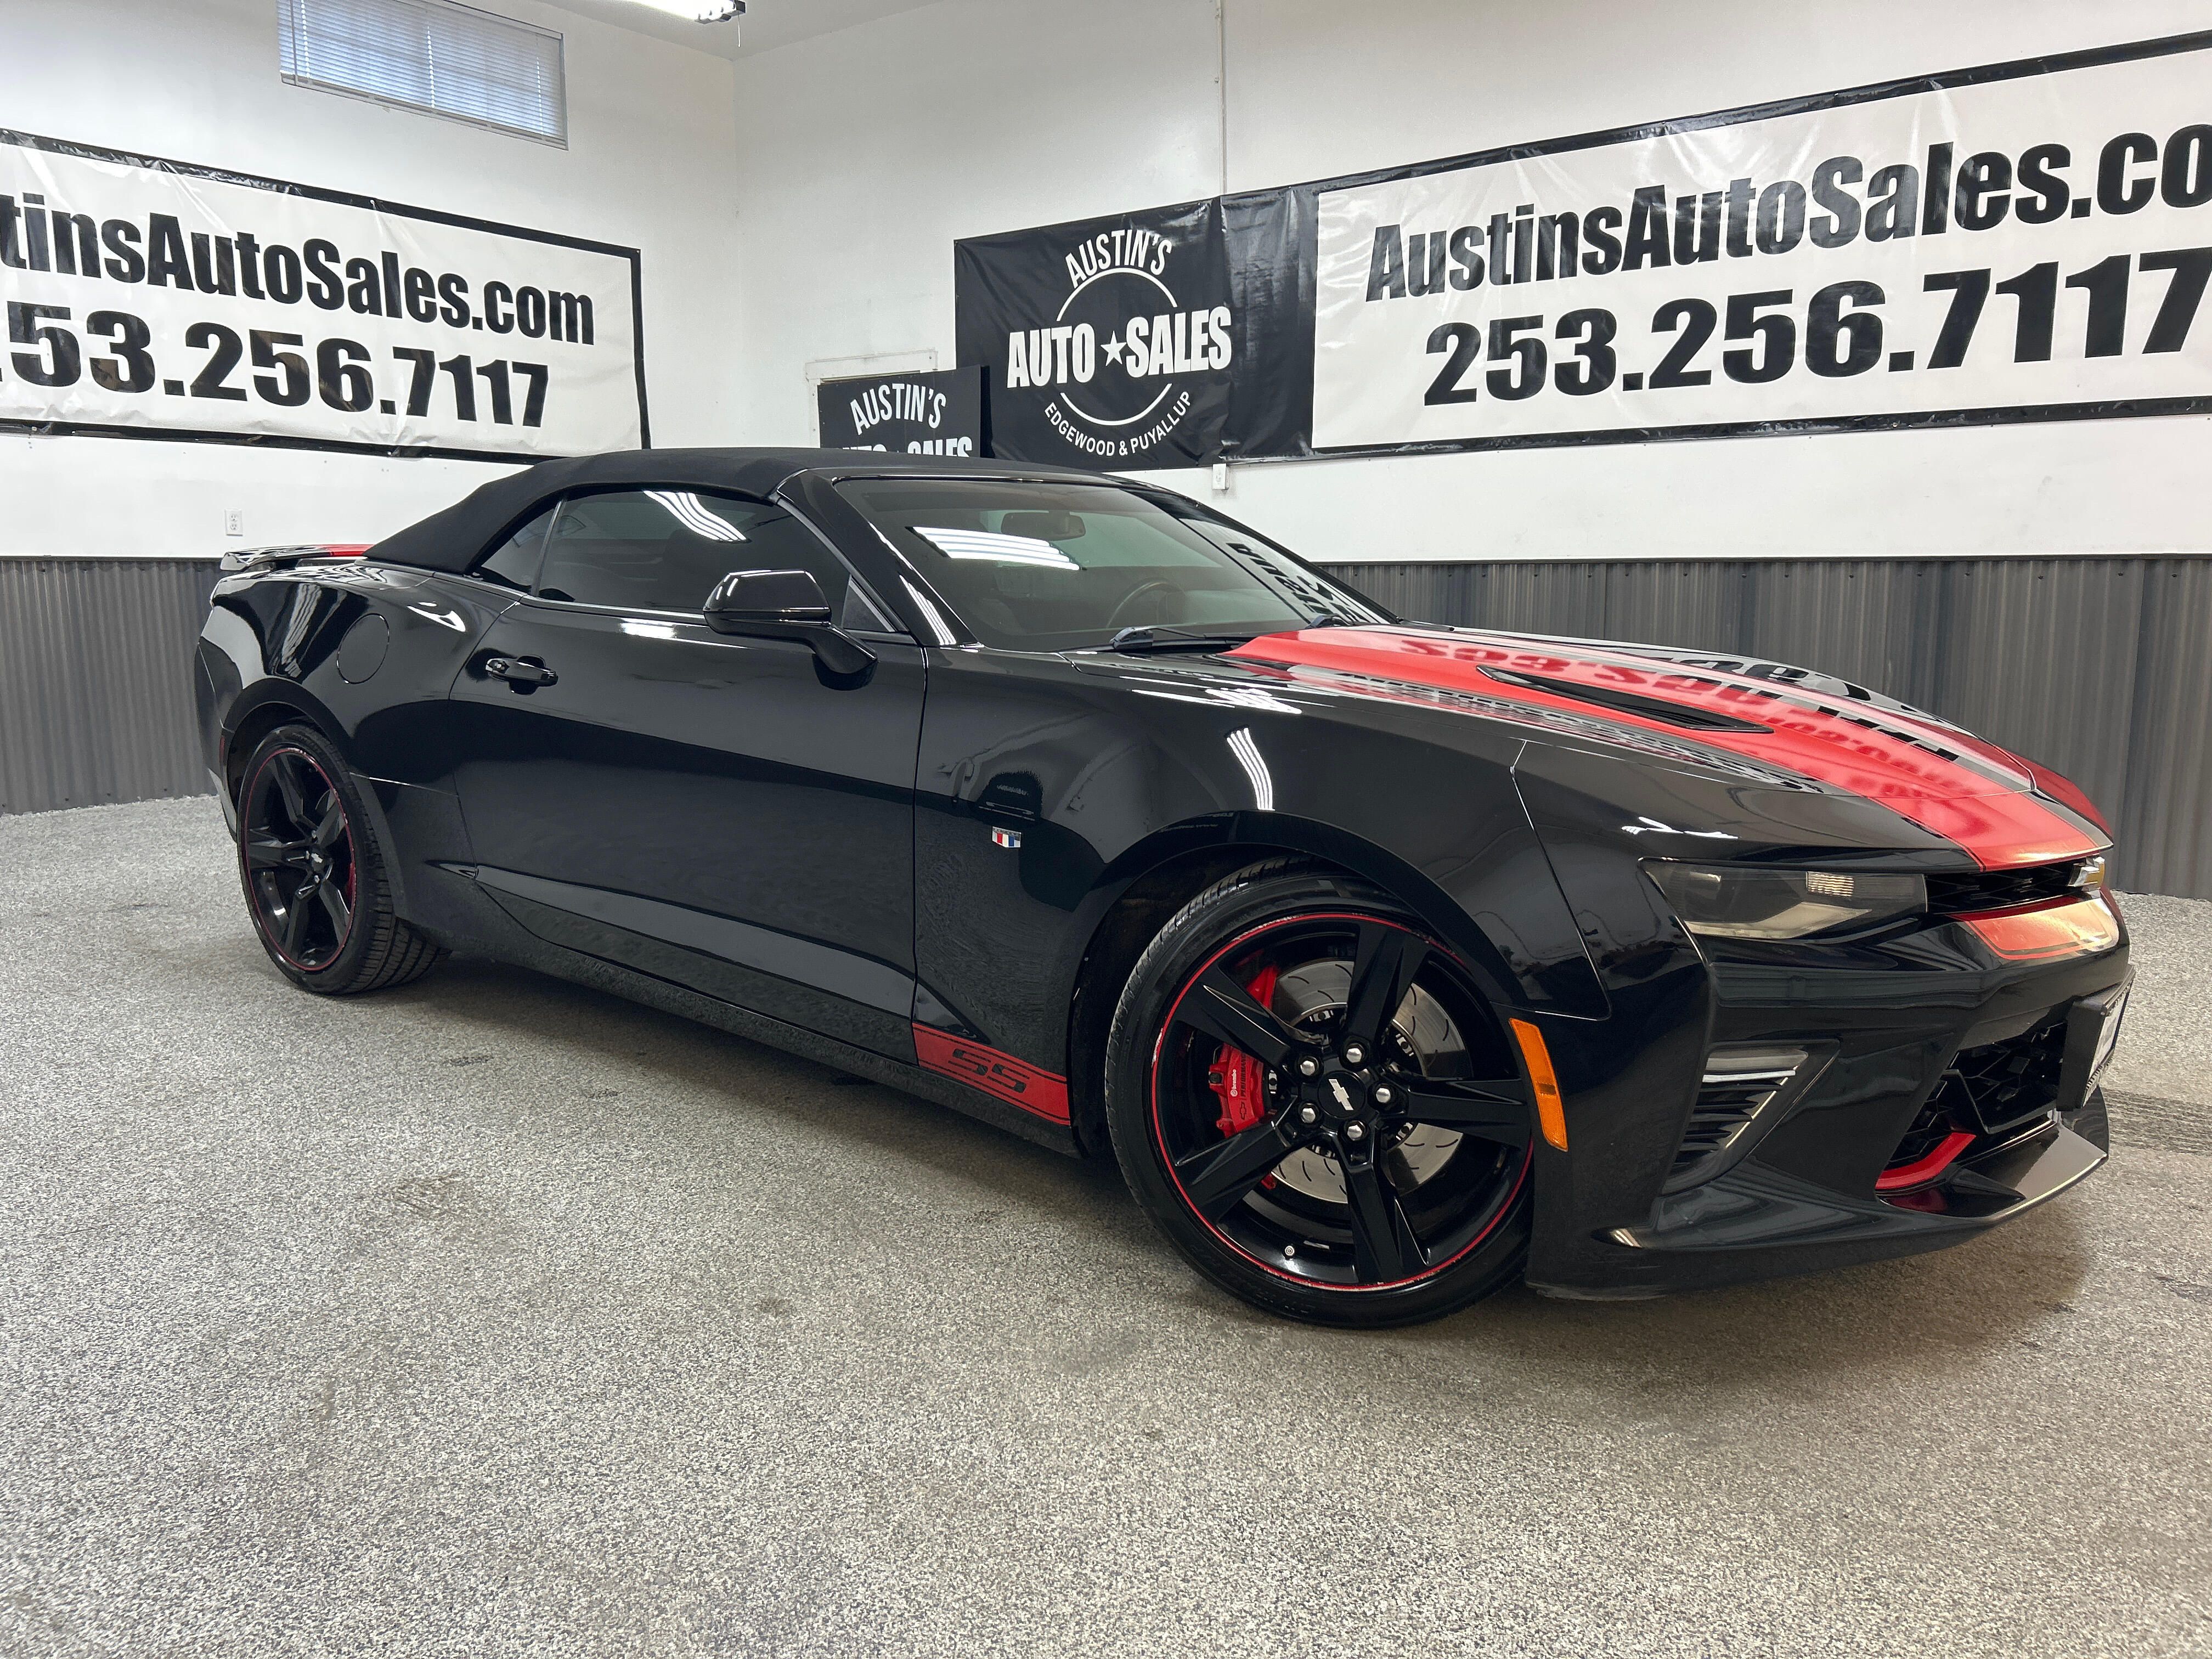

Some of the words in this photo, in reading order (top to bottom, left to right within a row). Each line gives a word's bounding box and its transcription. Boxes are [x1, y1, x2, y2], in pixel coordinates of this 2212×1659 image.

[1366, 124, 2212, 302] AustinsAutoSales.co
[0, 193, 594, 345] tinsAutoSales.com
[1065, 229, 1172, 288] AUSTIN'S
[0, 301, 548, 427] 53.256.7117
[1007, 323, 1094, 388] AUTO
[1126, 306, 1233, 378] SALES
[1424, 246, 2212, 406] 253.256.7117
[850, 383, 946, 436] AUSTIN'S
[1044, 402, 1115, 456] EDGEWOOD
[1119, 443, 1127, 456] &
[1131, 391, 1192, 454] PUYALLUP
[948, 1048, 1030, 1093] SS
